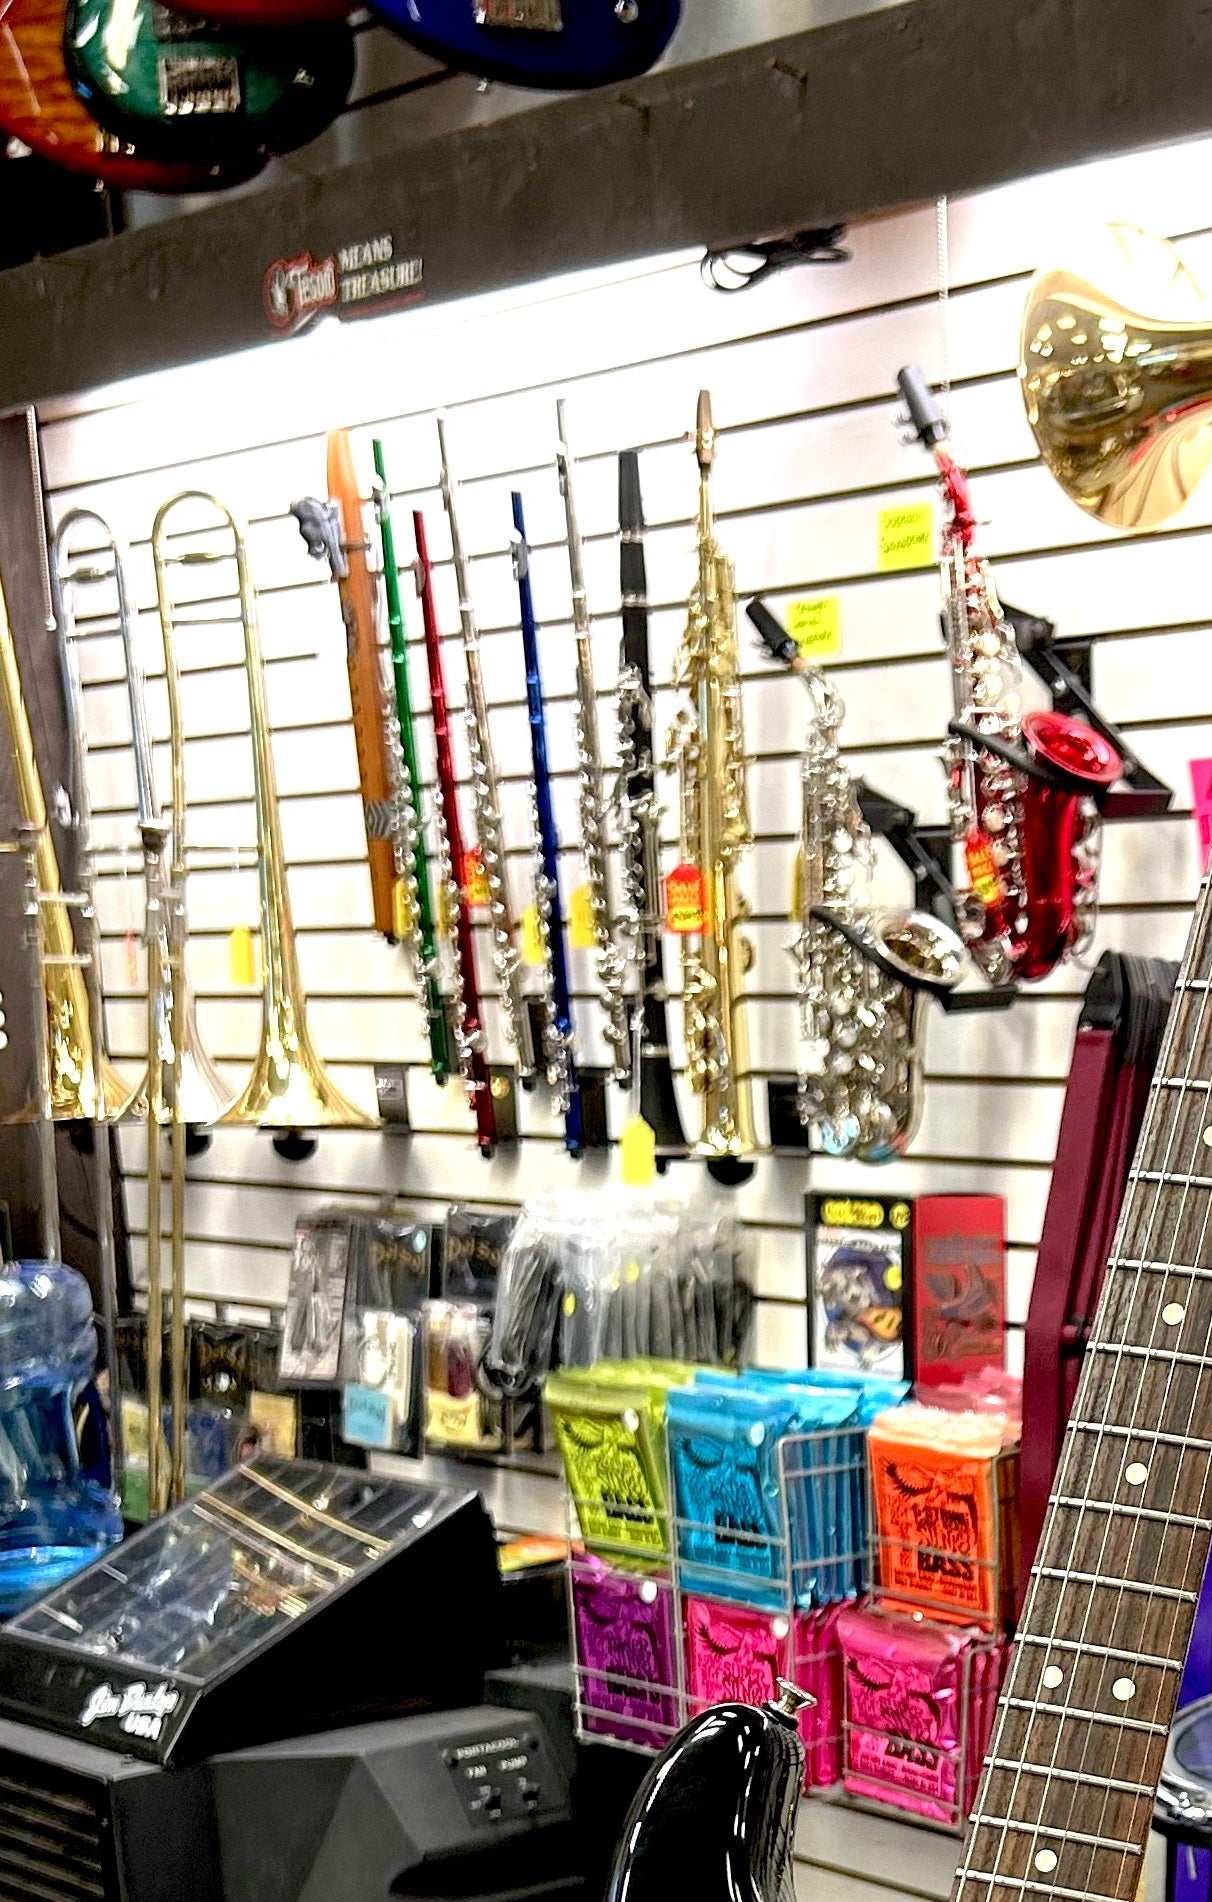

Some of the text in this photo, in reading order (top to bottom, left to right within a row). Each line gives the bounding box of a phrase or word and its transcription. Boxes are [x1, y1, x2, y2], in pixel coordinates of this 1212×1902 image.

[82, 1681, 178, 1726] Jim Dunlop
[124, 1712, 162, 1740] USA
